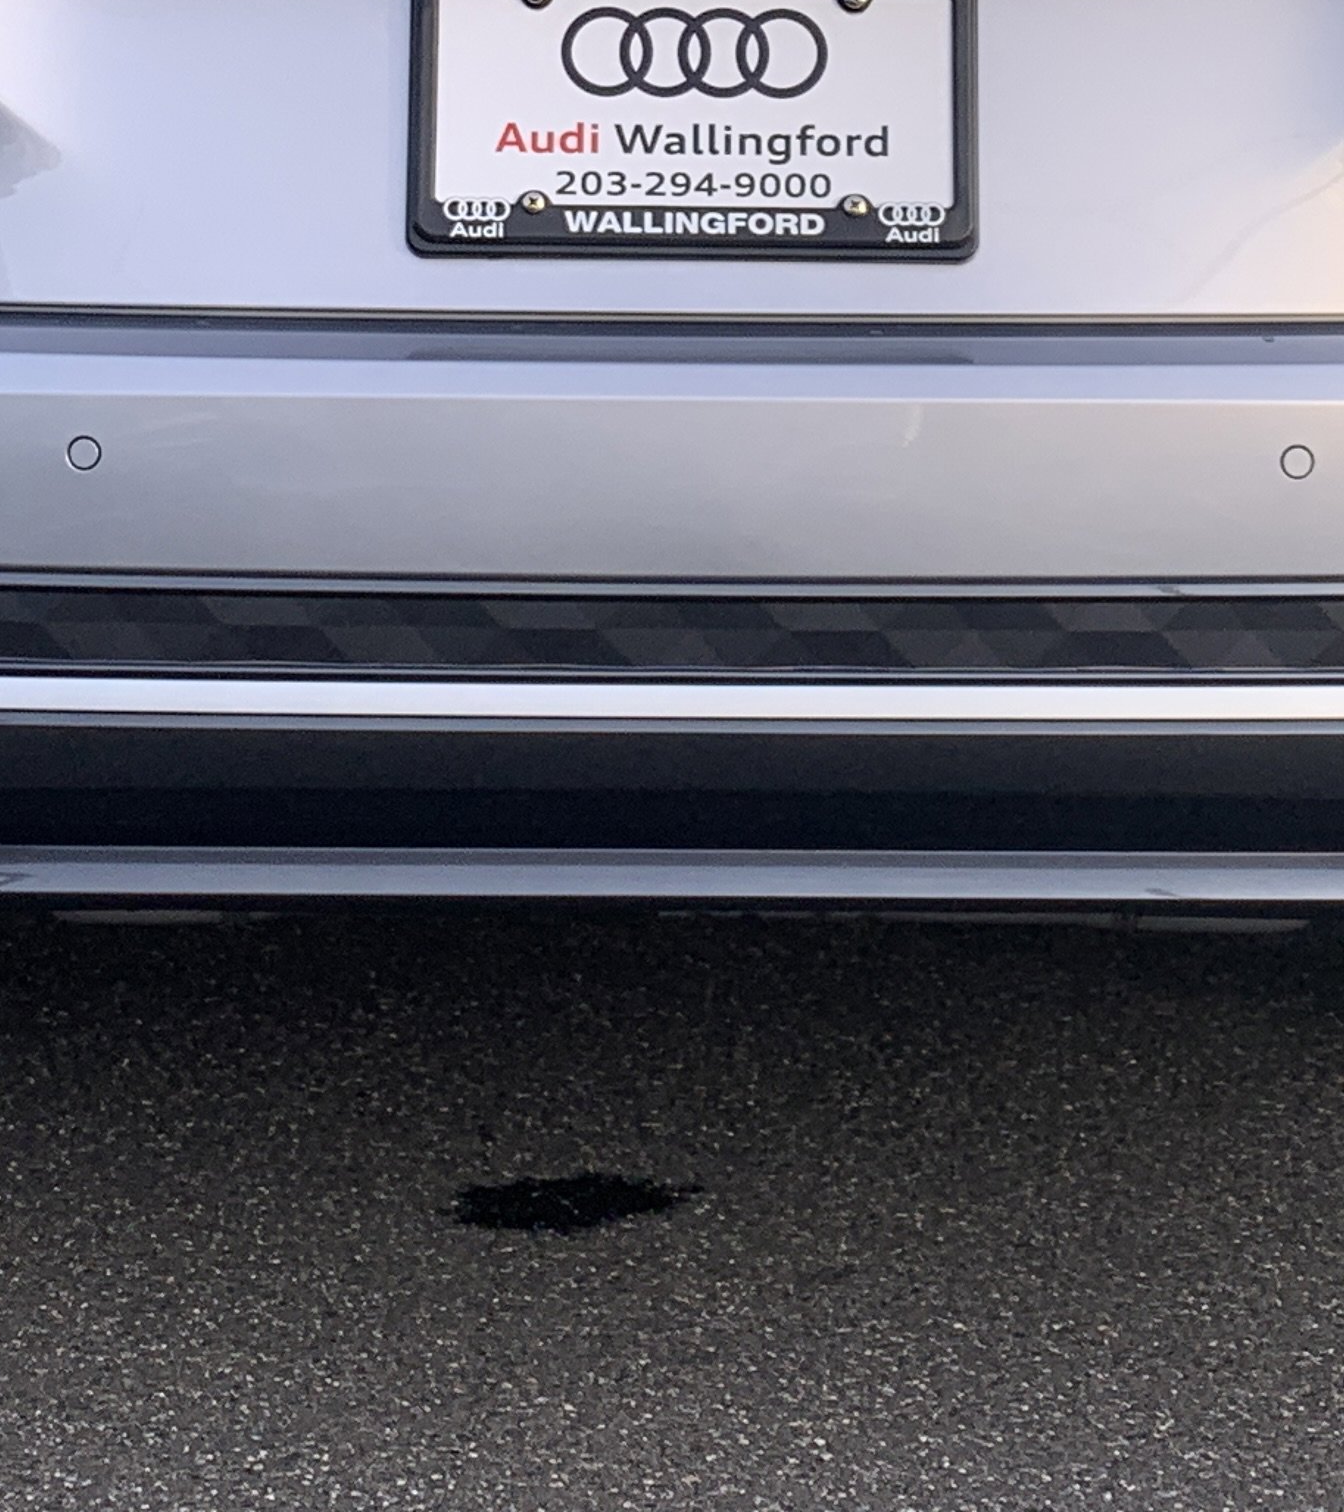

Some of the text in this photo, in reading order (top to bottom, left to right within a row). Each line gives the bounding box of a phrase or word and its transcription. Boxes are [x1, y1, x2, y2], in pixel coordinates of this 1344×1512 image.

[495, 121, 890, 164] Audi Wallingford
[555, 171, 832, 197] 203-294-9000
[450, 222, 504, 239] Audi
[564, 210, 826, 236] WALLINGFORD
[885, 227, 939, 244] Audi
